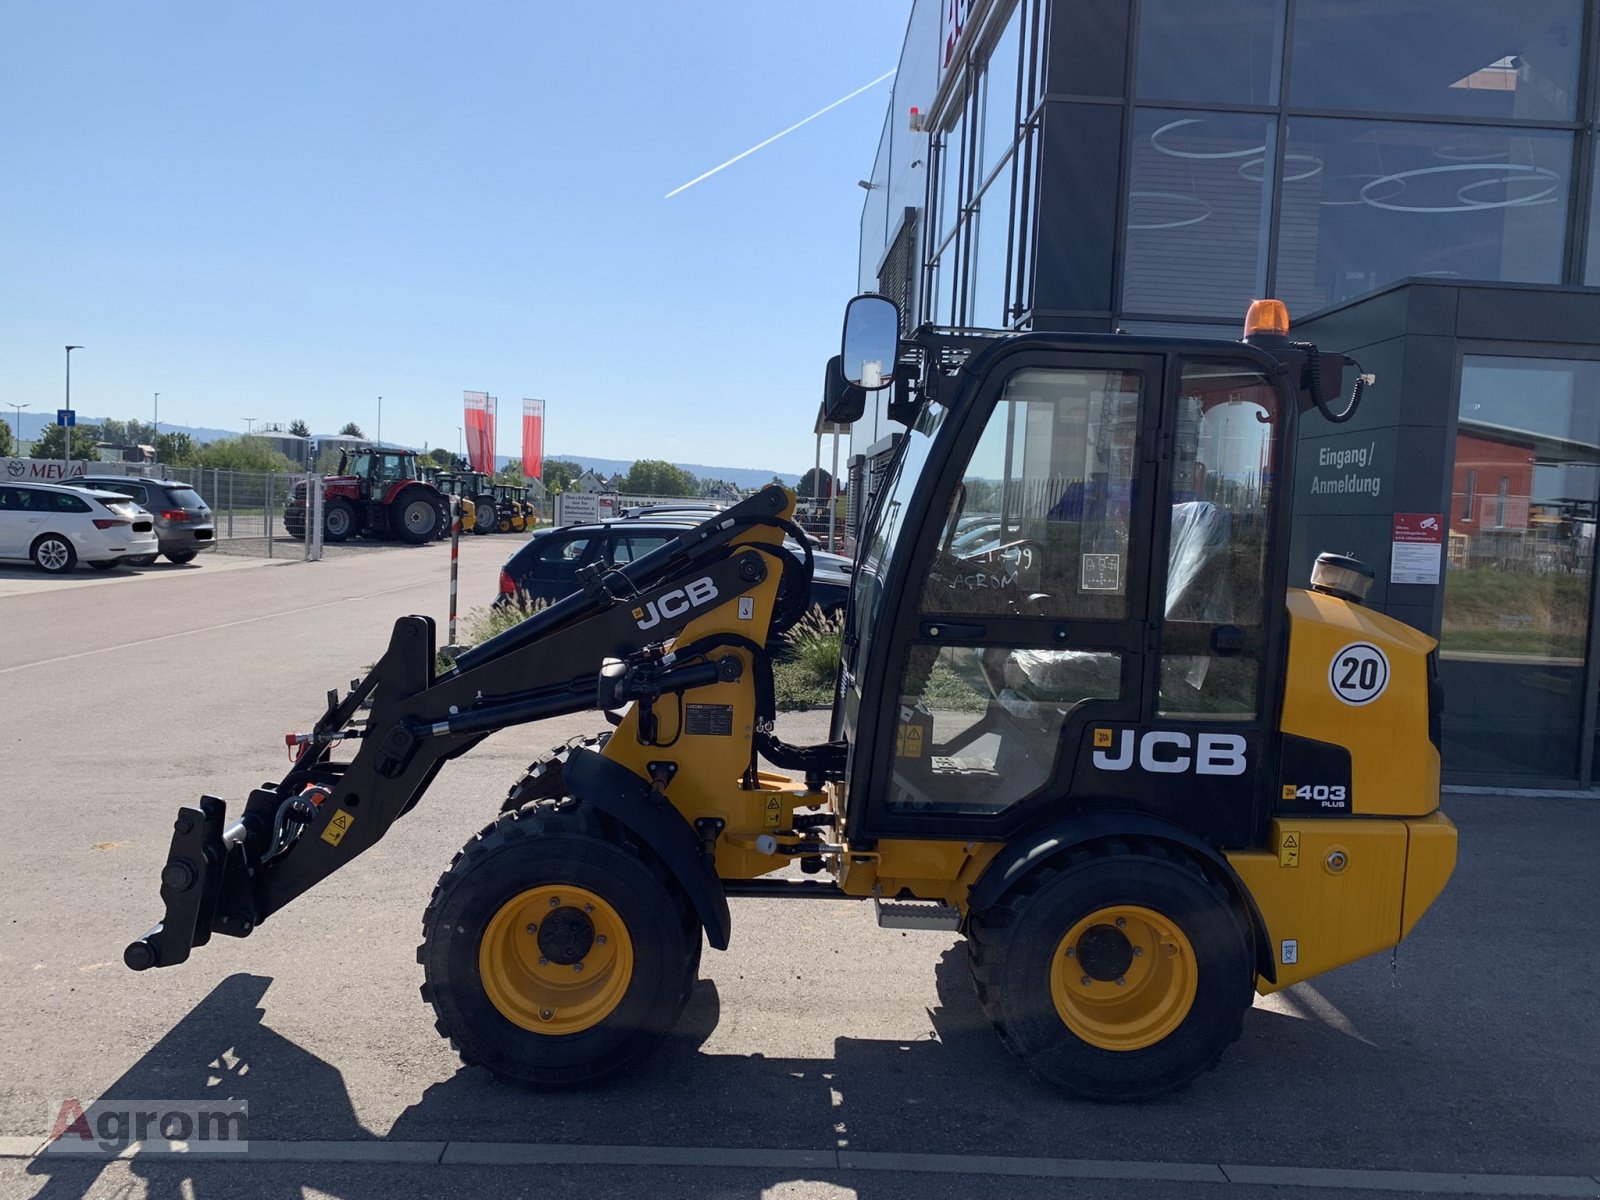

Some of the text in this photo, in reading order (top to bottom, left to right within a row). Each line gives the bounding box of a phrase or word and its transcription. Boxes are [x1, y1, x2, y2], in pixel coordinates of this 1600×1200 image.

[1319, 441, 1375, 469] Eingang/
[1310, 473, 1381, 497] Anmeldung
[637, 576, 719, 630] JCB
[1340, 657, 1378, 690] 20
[1093, 729, 1247, 776] JCB
[1296, 785, 1346, 800] 403
